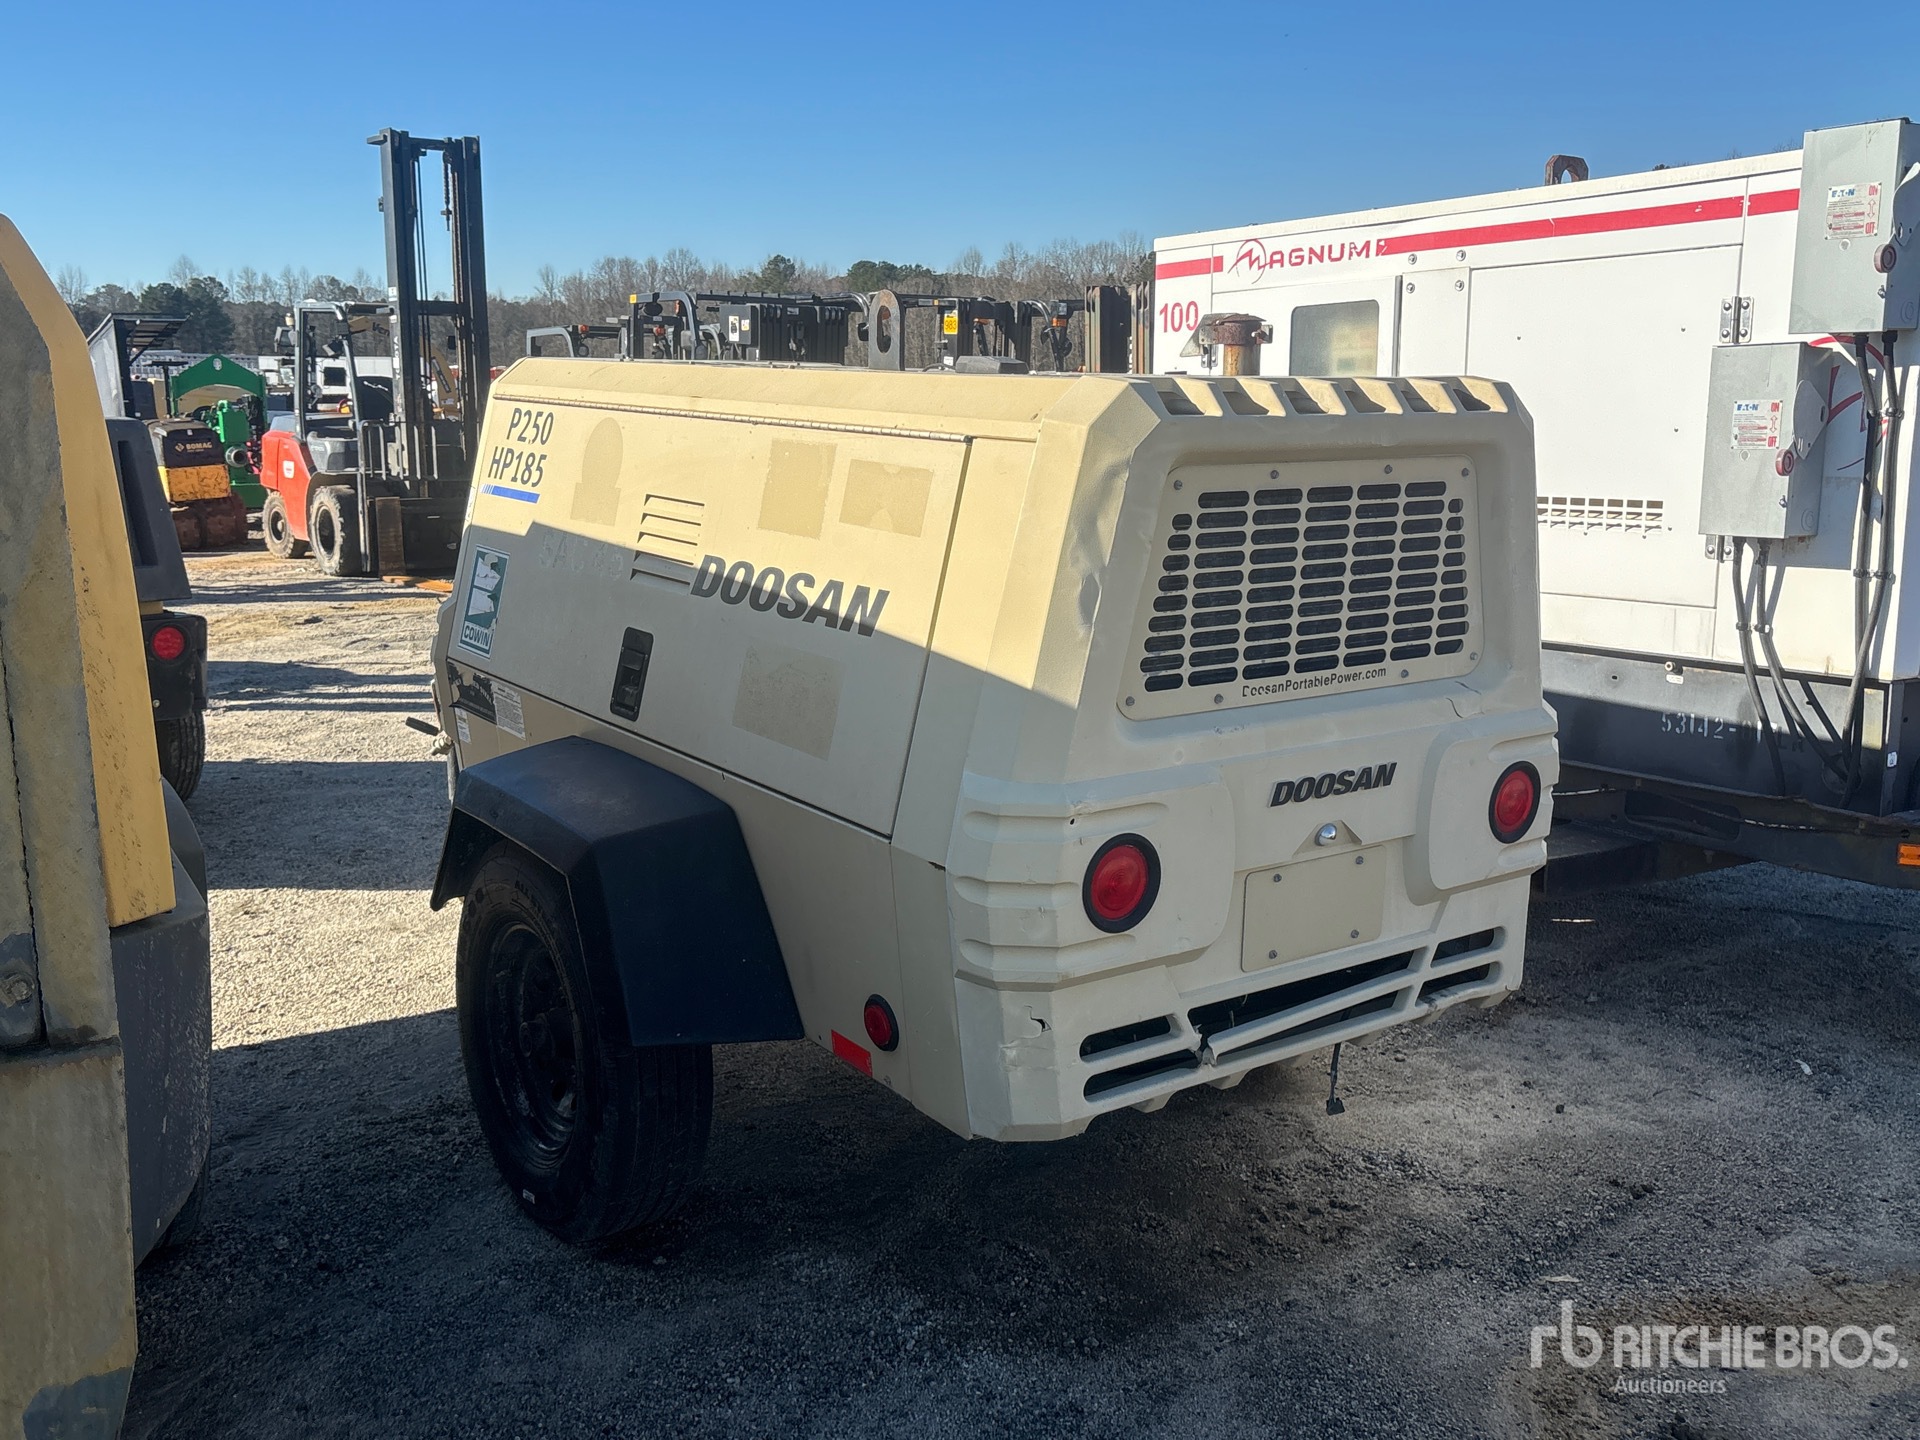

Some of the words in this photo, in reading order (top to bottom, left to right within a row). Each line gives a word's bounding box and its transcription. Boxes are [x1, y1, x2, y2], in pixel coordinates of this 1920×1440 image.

[1869, 185, 1879, 196] ON
[1228, 240, 1372, 275] MAGNUM
[1159, 300, 1199, 333] 100
[1771, 402, 1780, 413] ON
[506, 407, 554, 446] P250
[185, 441, 213, 450] BOMAG
[487, 445, 548, 488] HP185
[690, 554, 890, 637] DOOSAN
[463, 625, 490, 648] COWIN
[1242, 667, 1387, 698] DoosanPortablePower.com
[1269, 762, 1398, 807] DOOSAN
